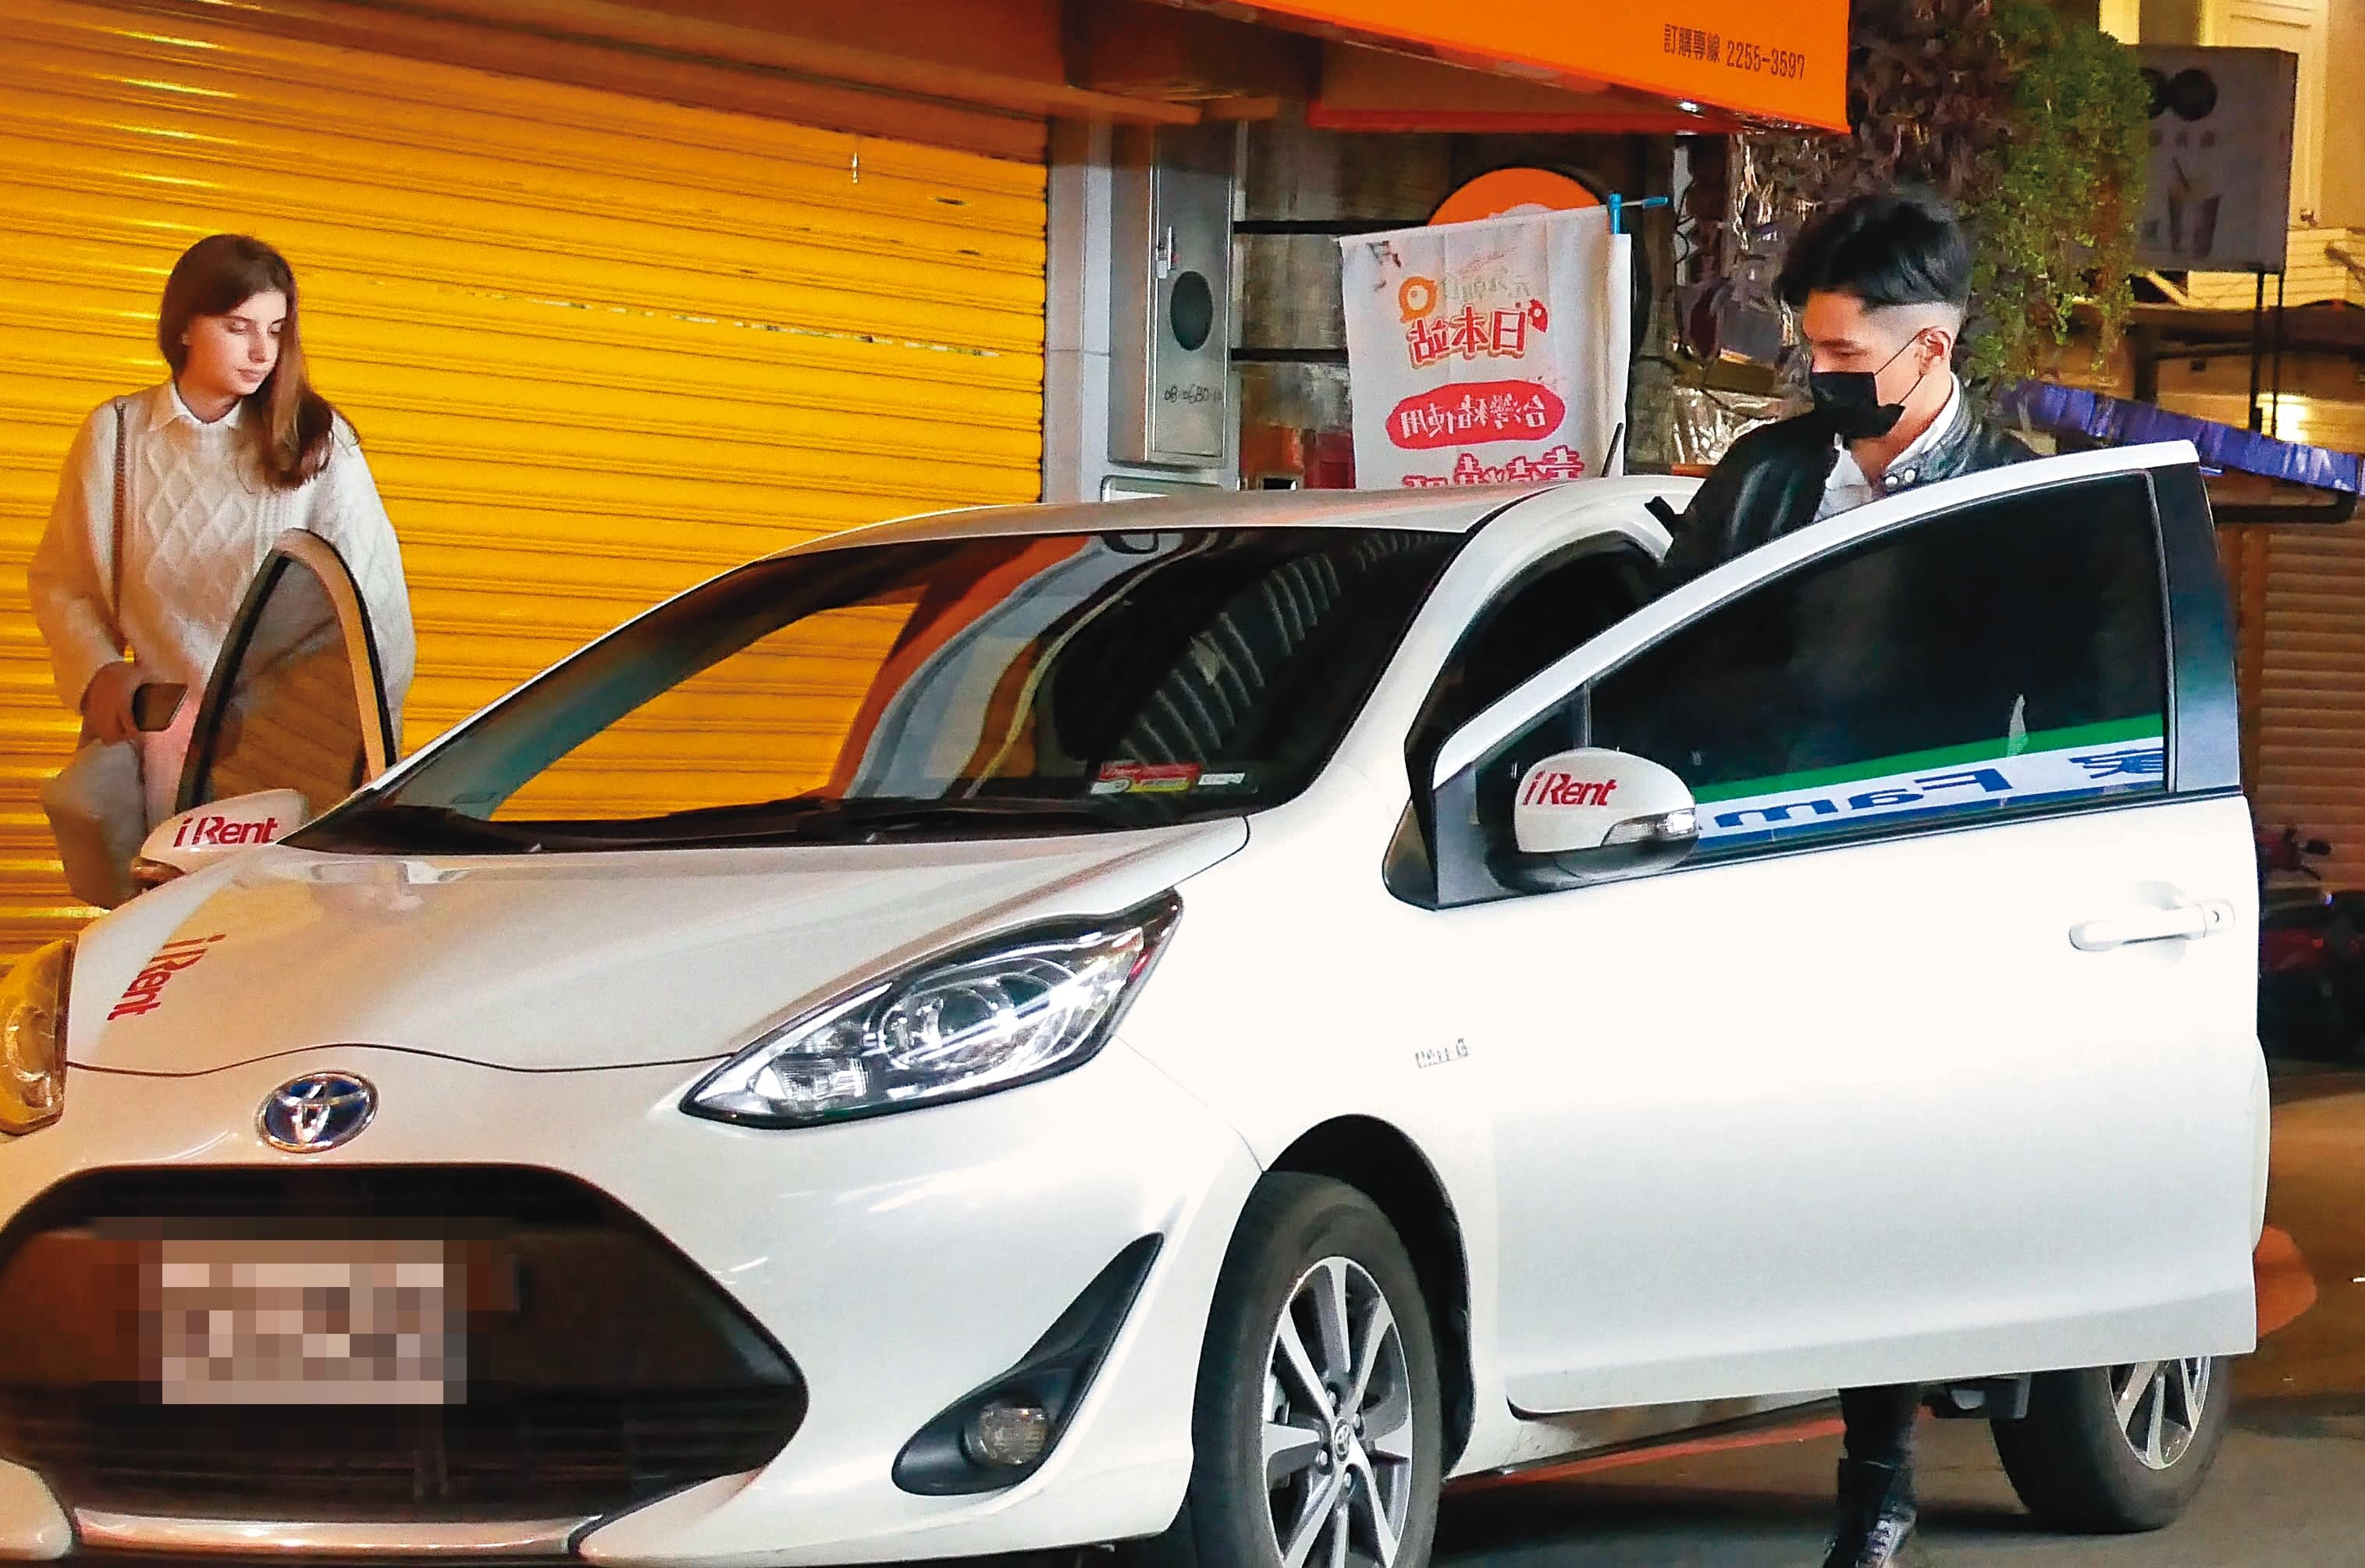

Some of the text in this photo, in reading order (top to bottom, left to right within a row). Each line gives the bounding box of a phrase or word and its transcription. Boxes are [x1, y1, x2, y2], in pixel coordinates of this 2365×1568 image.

[1663, 23, 1805, 80] 訂購專線 2255-3597
